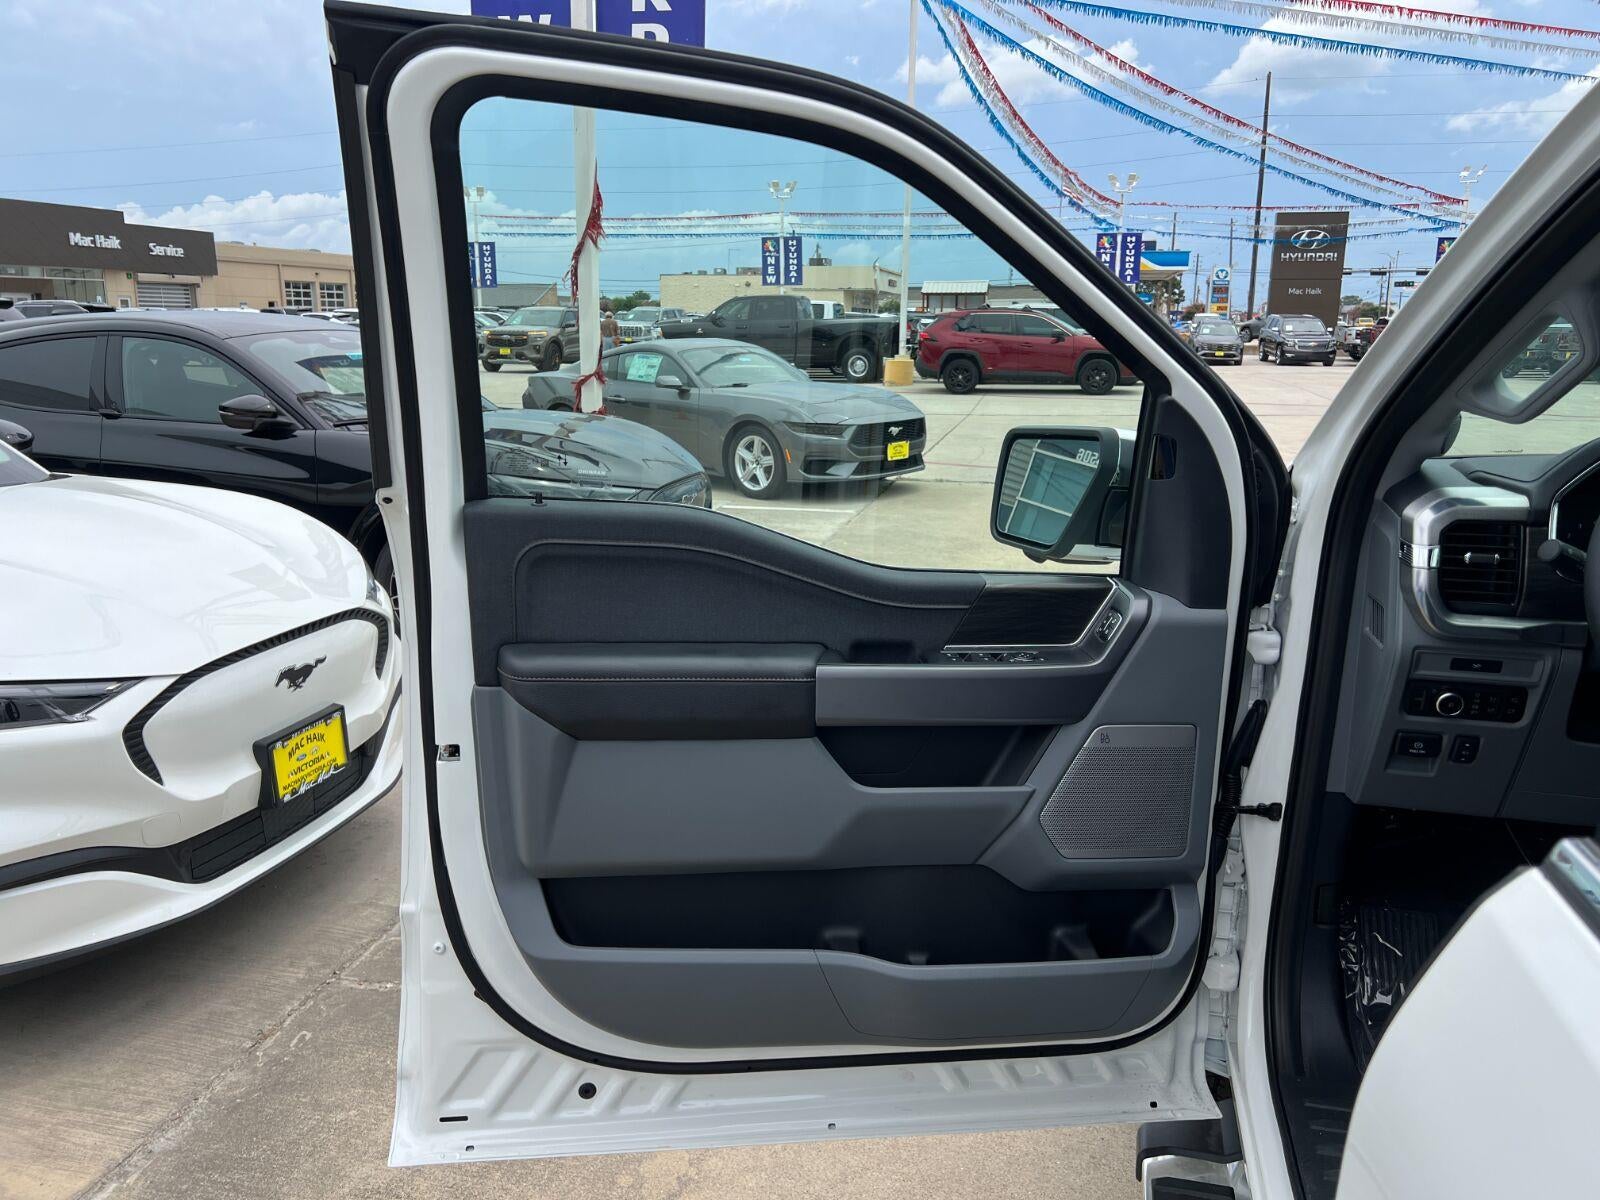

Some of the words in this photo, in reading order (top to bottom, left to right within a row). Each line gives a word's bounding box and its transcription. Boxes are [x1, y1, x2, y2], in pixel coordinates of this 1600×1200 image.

[68, 232, 95, 247] Mac
[95, 234, 122, 249] Haik
[148, 242, 184, 257] Service
[482, 244, 493, 286] HYUNDAI
[788, 239, 798, 283] HYUNDAI
[1124, 236, 1136, 282] HYUNDAI
[1280, 252, 1338, 262] HYUNDAI
[766, 257, 776, 283] NEW
[1288, 287, 1304, 295] Mac
[1305, 287, 1322, 295] Haik
[288, 737, 305, 760] MAC
[306, 732, 326, 744] HAIK
[292, 753, 325, 776] VICTORIA
